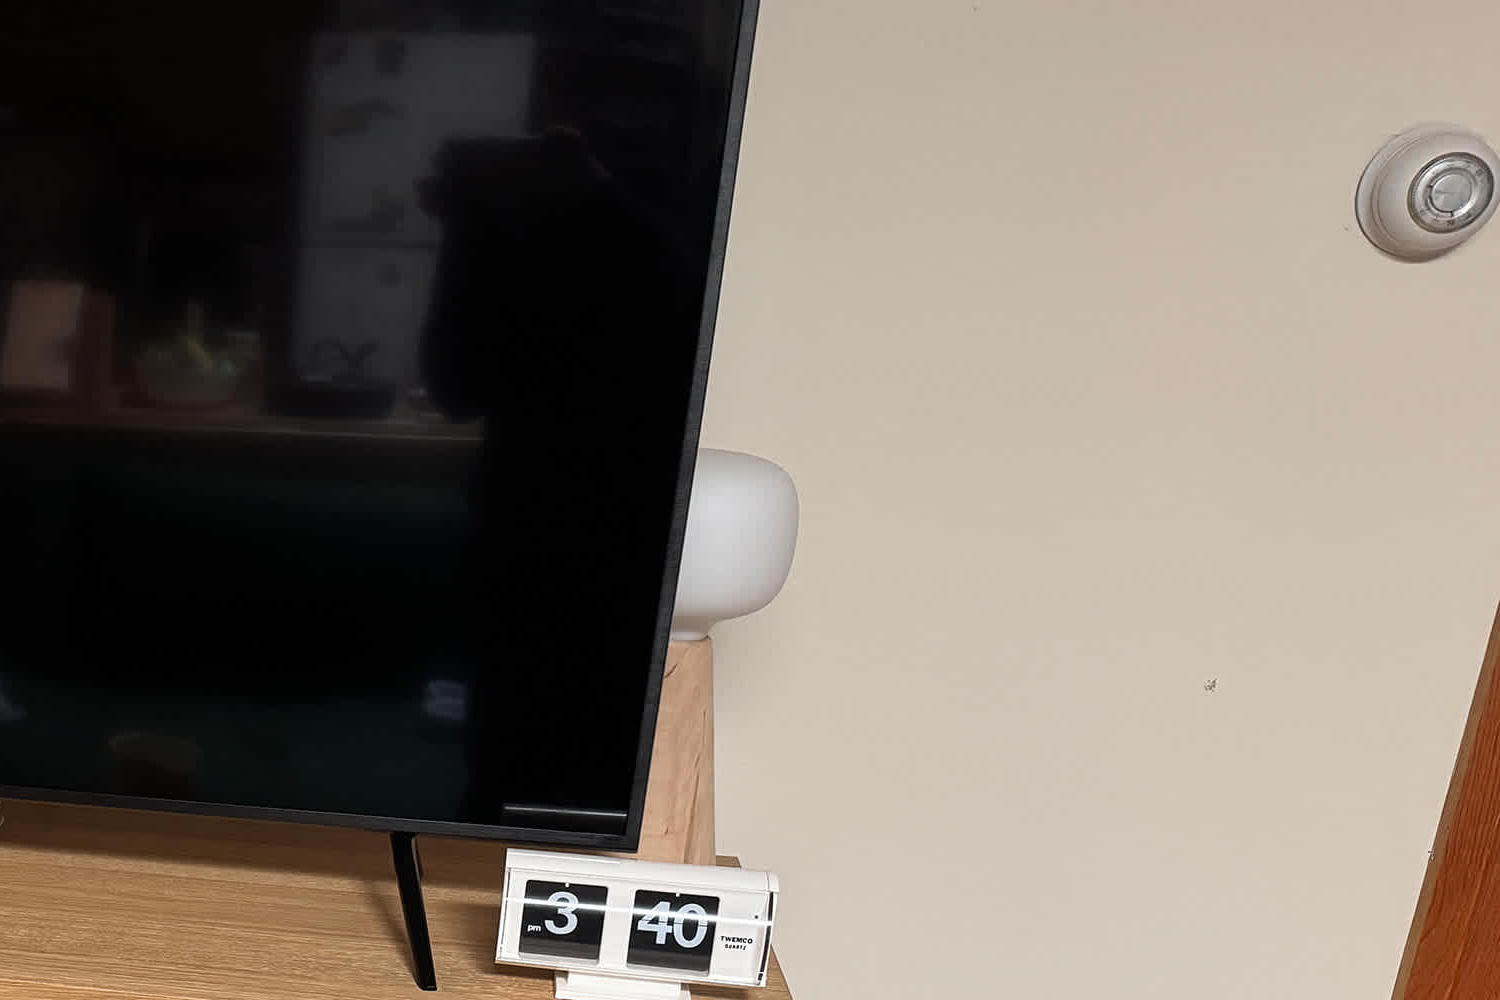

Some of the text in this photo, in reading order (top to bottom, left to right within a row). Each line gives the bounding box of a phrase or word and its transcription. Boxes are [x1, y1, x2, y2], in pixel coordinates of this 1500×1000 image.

[544, 891, 708, 948] 3 40
[527, 924, 542, 933] pm
[720, 935, 753, 944] TWEMCO
